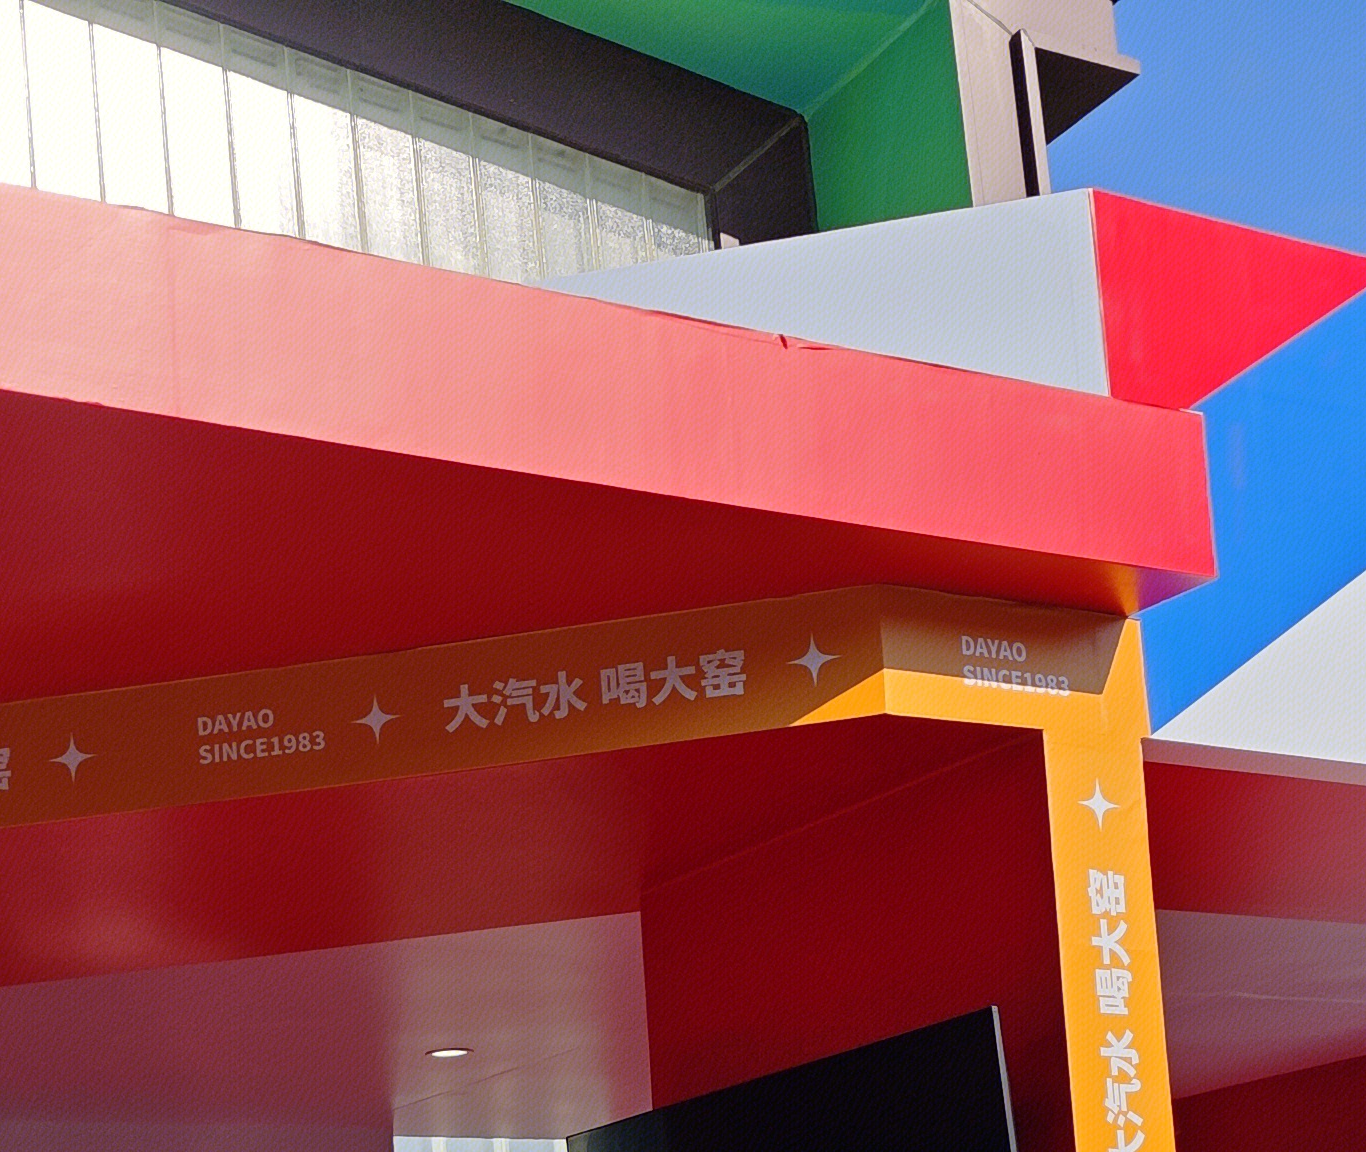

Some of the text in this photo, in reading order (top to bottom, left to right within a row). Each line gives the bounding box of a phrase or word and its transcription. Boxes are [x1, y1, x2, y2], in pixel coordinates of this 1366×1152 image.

[960, 634, 1027, 663] DAYAO
[442, 649, 748, 733] 大汽水 喝大窑
[962, 664, 1072, 697] SINCE1983
[197, 707, 275, 737] DAYAO
[198, 730, 327, 765] SINCE1983
[1087, 868, 1133, 1015] 喝大窑
